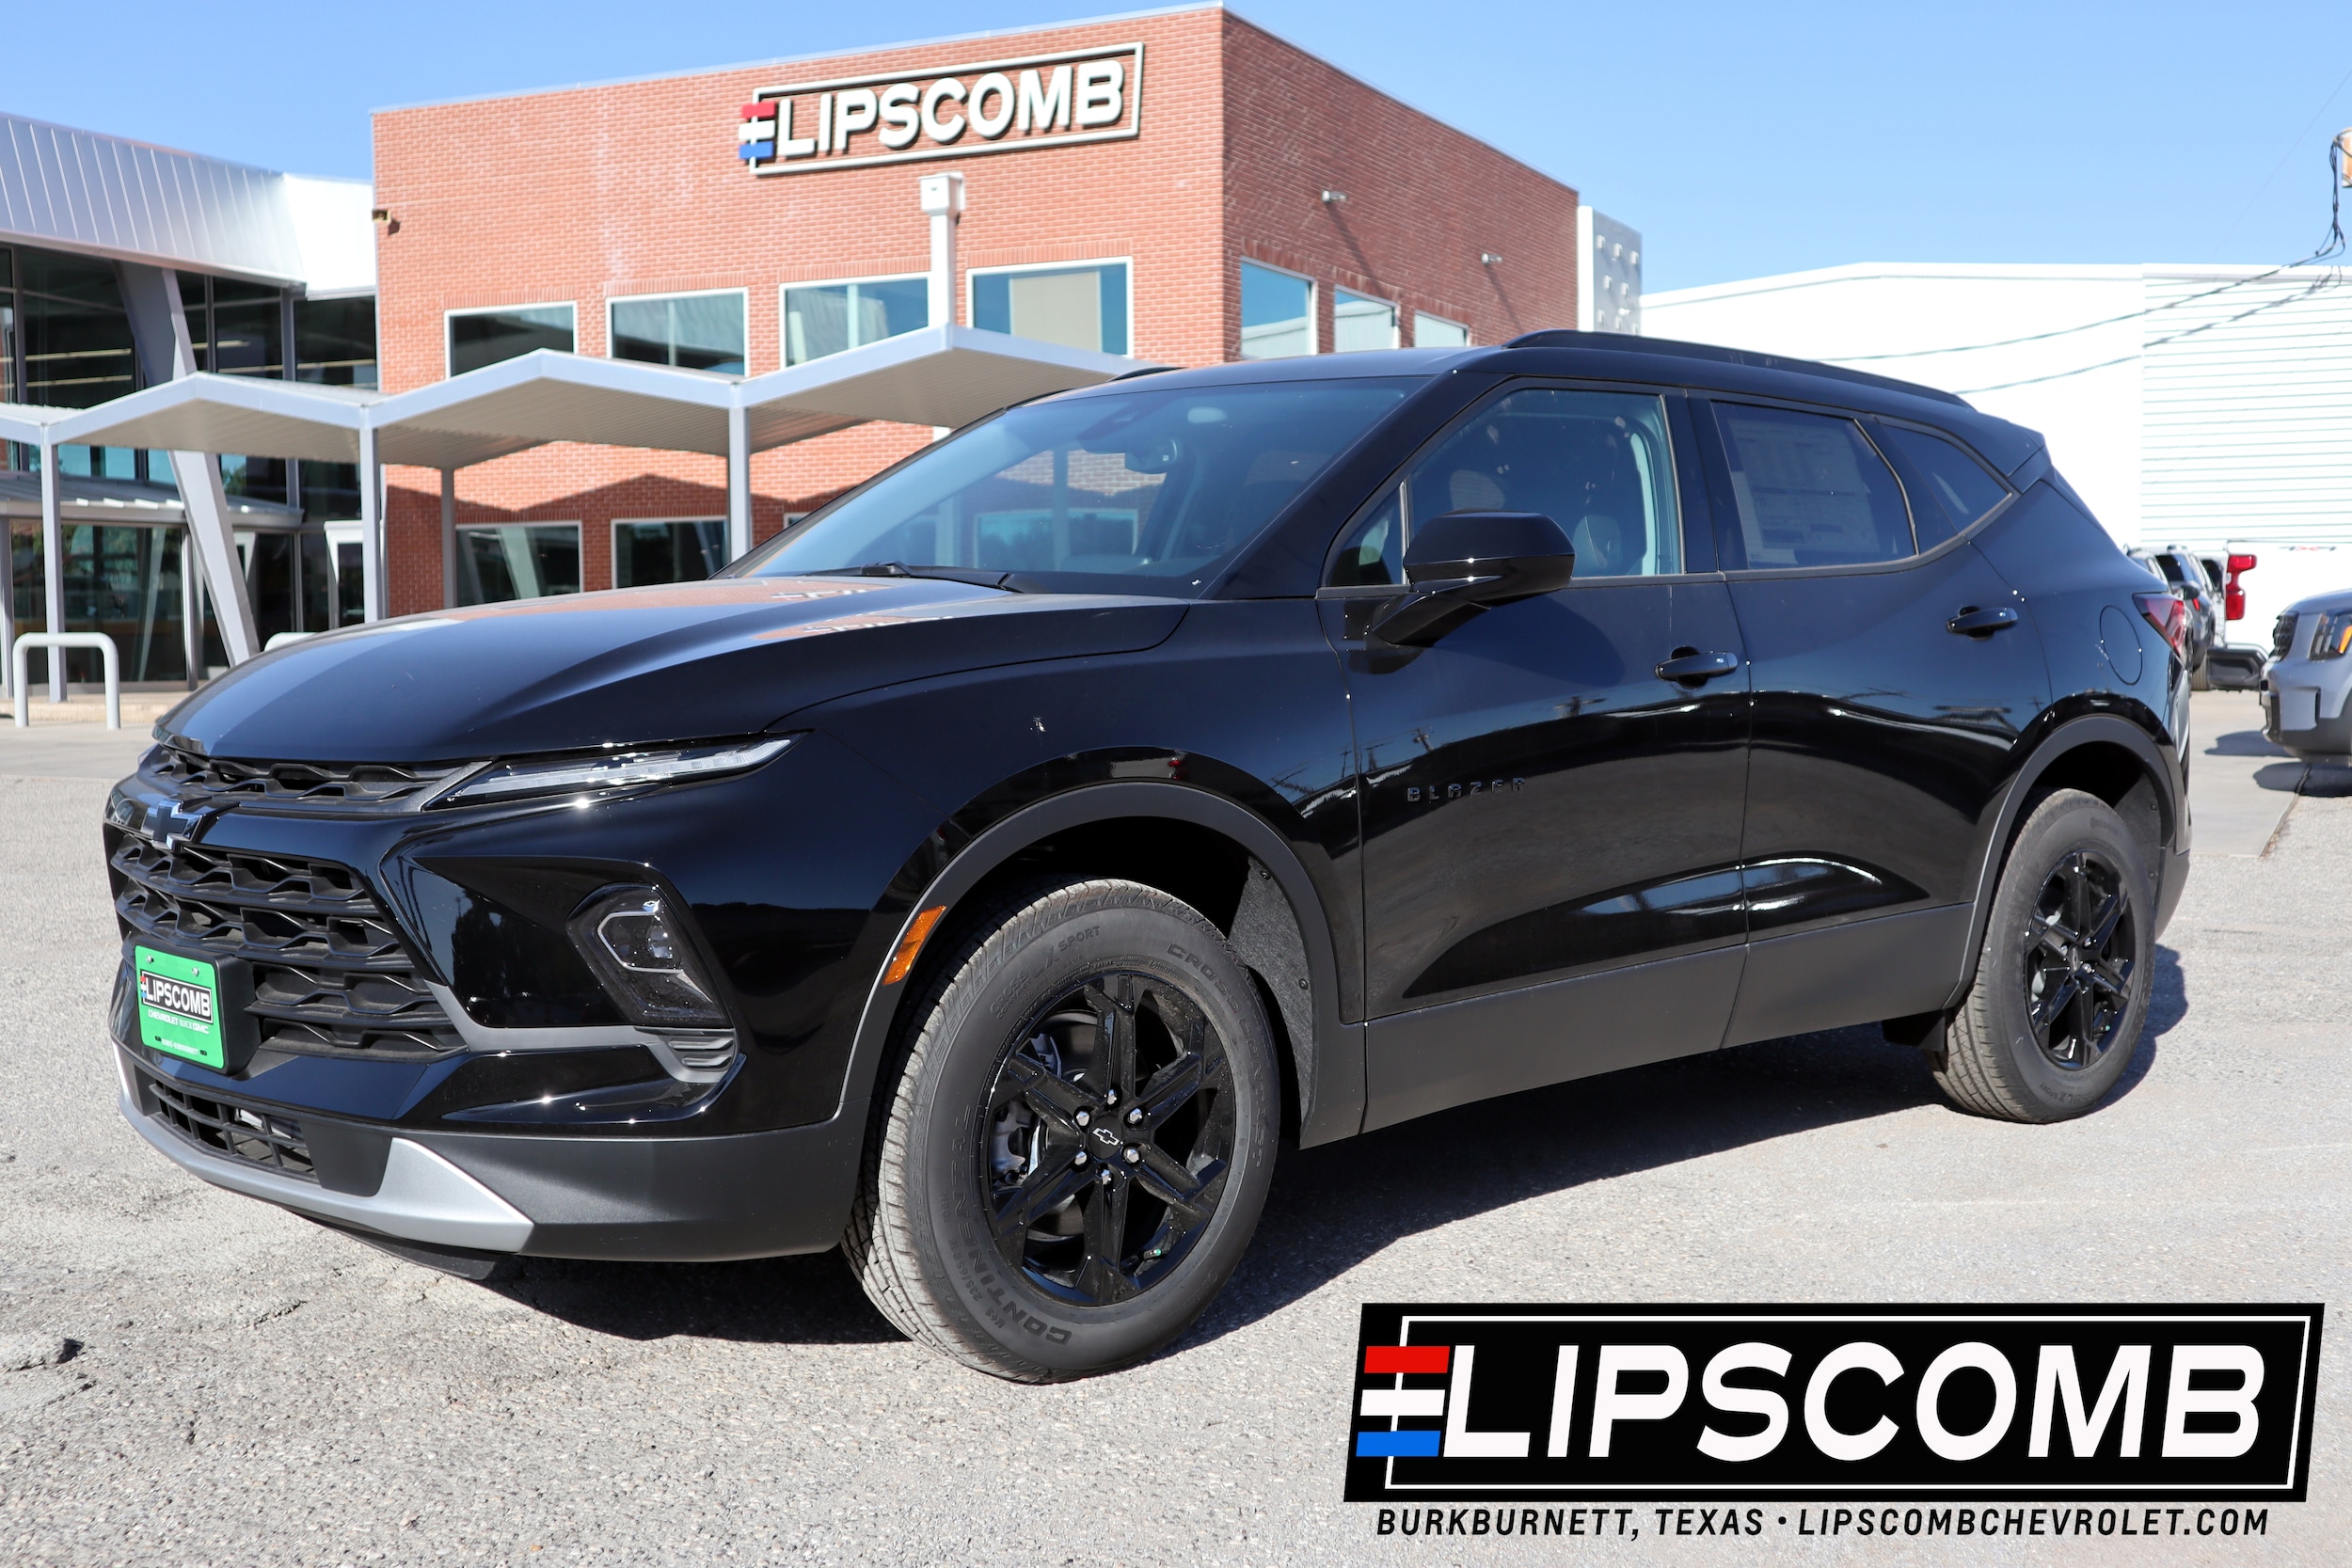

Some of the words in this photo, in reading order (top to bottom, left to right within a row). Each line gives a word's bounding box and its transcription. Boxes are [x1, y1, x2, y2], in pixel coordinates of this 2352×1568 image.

[776, 59, 1125, 158] LIPSCOMB
[1406, 777, 1525, 801] BLAZER
[1057, 926, 1101, 953] SPORT
[146, 977, 211, 1017] LIPSCOMB
[1167, 942, 1242, 1014] CROSS
[148, 1008, 179, 1026] CHEVROLET
[192, 1022, 210, 1035] GMC
[950, 1103, 1073, 1346] CONTINENTAL
